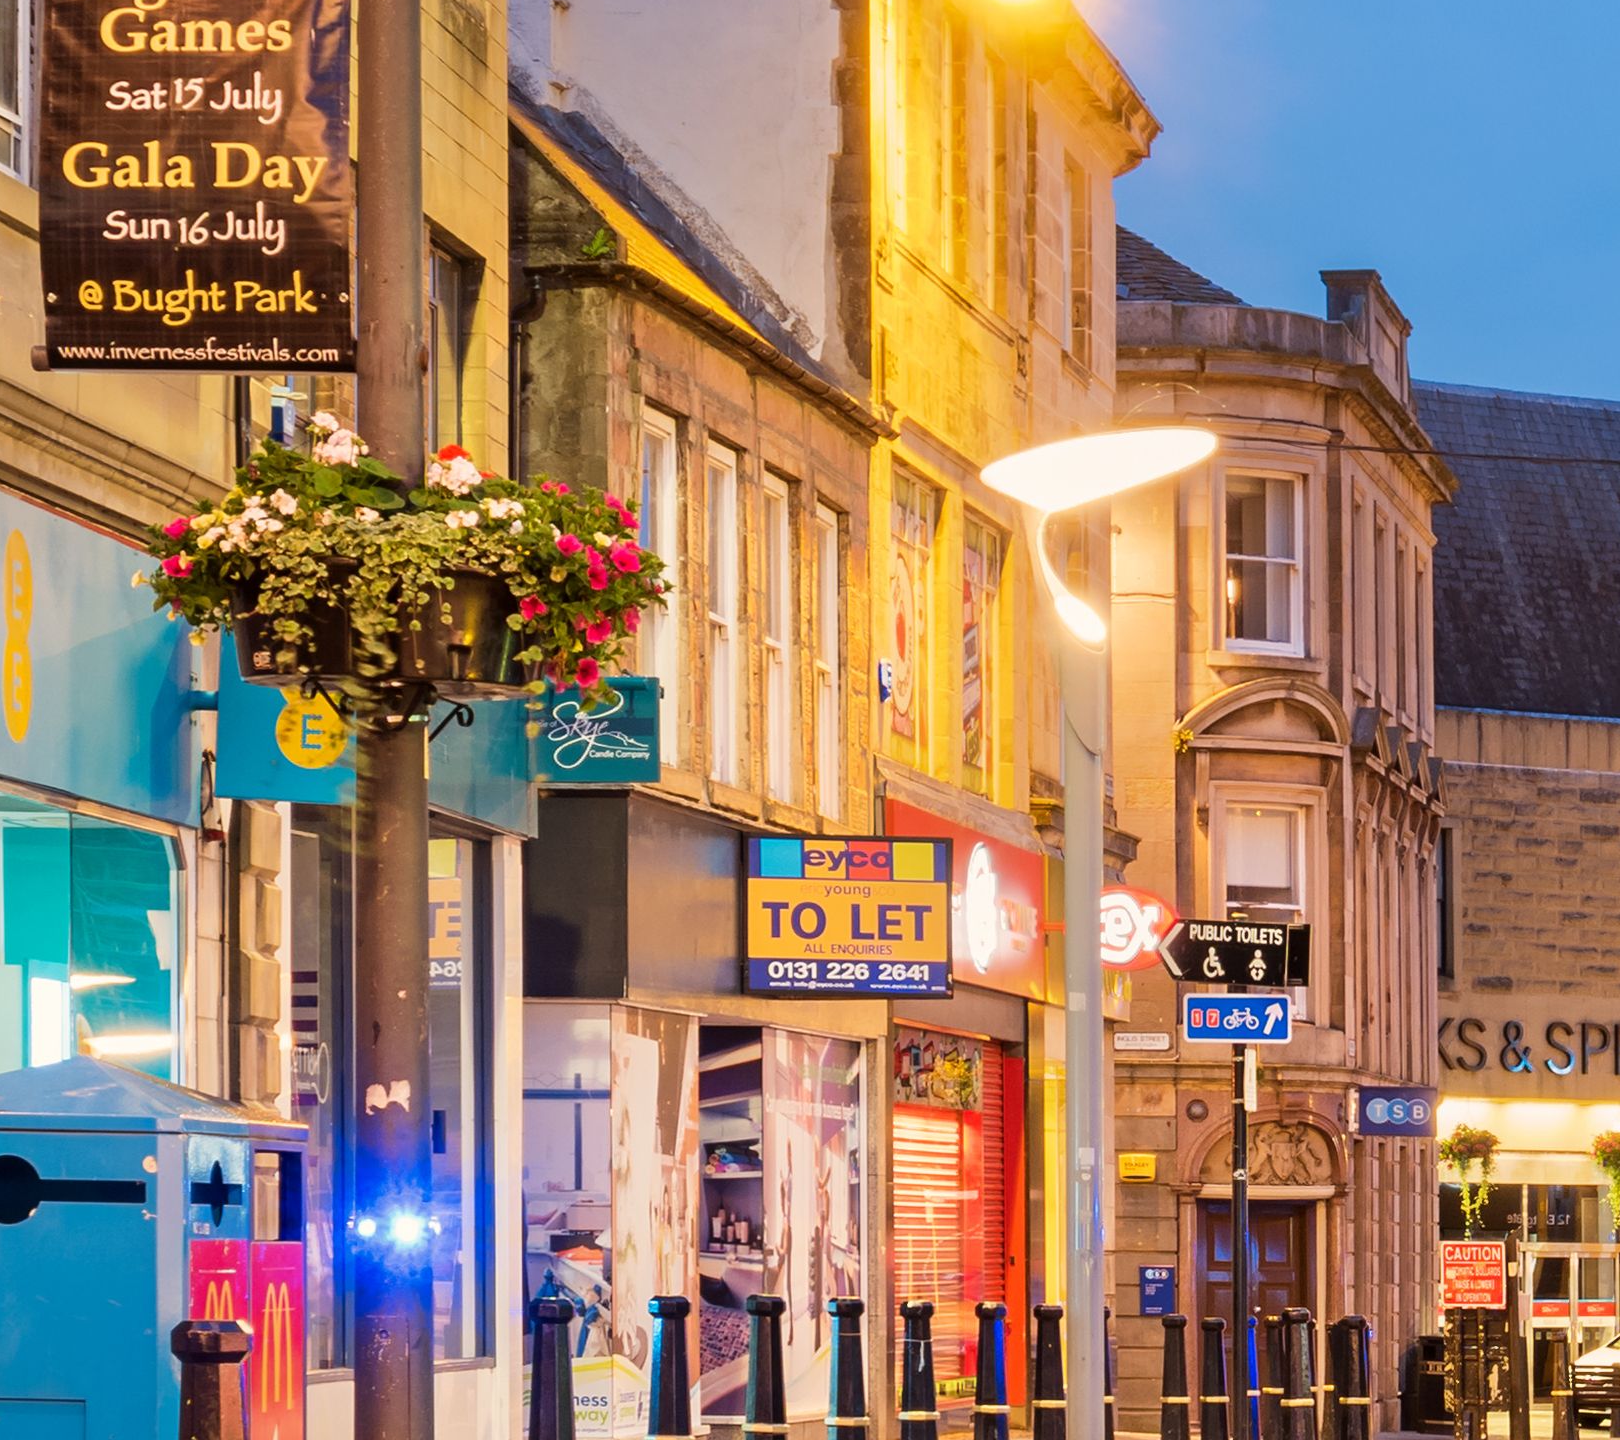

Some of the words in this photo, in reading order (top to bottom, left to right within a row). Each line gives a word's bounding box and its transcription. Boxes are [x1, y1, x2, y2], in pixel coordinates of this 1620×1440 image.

[100, 8, 292, 53] Games
[106, 81, 168, 112] Sat
[173, 77, 204, 110] 15
[210, 71, 283, 125] July
[62, 141, 194, 189] Gala
[212, 141, 328, 203] Day
[102, 210, 170, 240] Sun
[179, 211, 209, 246] 16
[212, 201, 285, 255] July
[78, 280, 103, 310] @
[112, 270, 226, 326] Bught
[235, 270, 317, 314] Park
[58, 336, 339, 364] www.invernessfestivals.com
[589, 749, 615, 759] Candle
[616, 749, 650, 761] Company
[804, 849, 891, 872] eyco
[762, 901, 826, 940] TO
[851, 903, 932, 941] LET
[1189, 924, 1233, 942] PUBLIC
[1235, 926, 1283, 946] TOILETS
[804, 943, 826, 954] ALL
[831, 944, 892, 956] ENQUIRIES
[768, 961, 818, 979] 0131
[826, 964, 870, 980] 226
[878, 964, 929, 981] 2641
[1500, 1020, 1533, 1074] &
[1445, 1246, 1501, 1261] CAUTION
